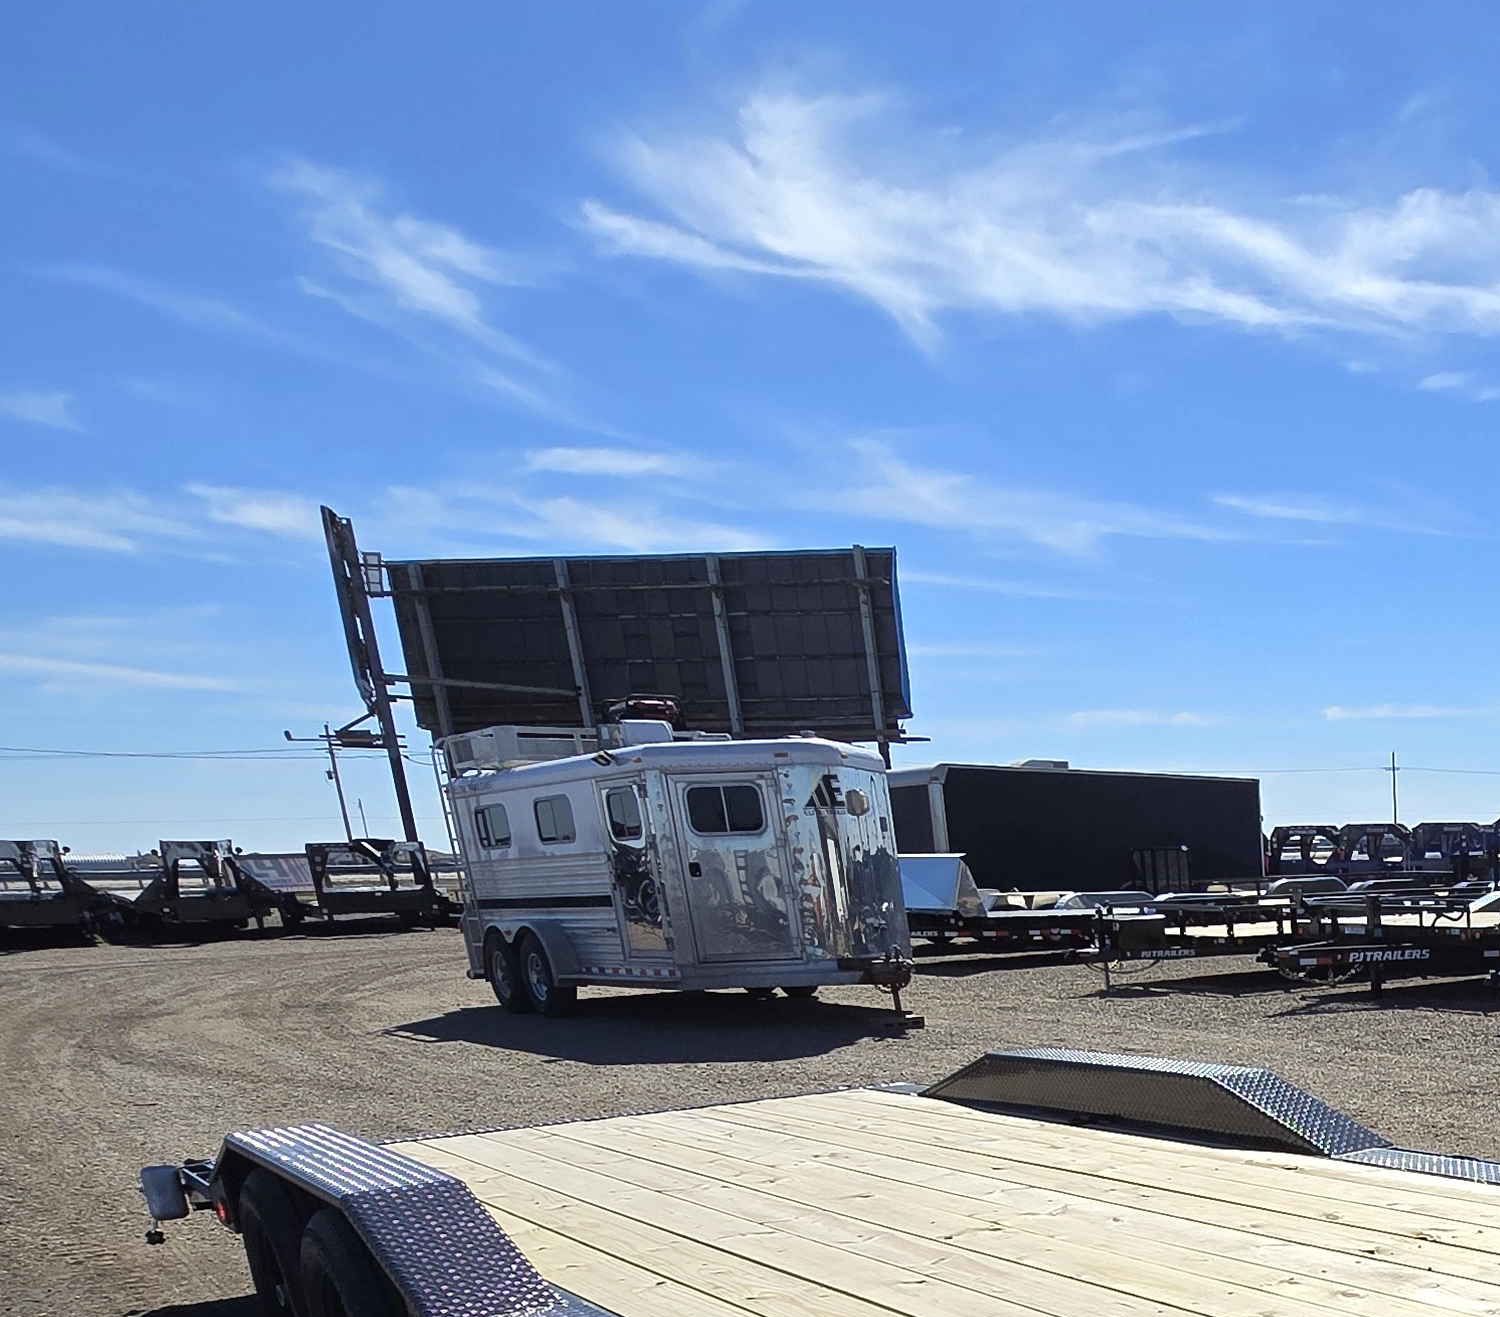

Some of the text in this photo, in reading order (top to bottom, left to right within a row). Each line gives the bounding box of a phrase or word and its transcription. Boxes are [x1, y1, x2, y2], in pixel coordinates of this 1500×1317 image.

[1152, 949, 1196, 957] TRAILERS
[1349, 949, 1430, 963] PJ TRAILERS
